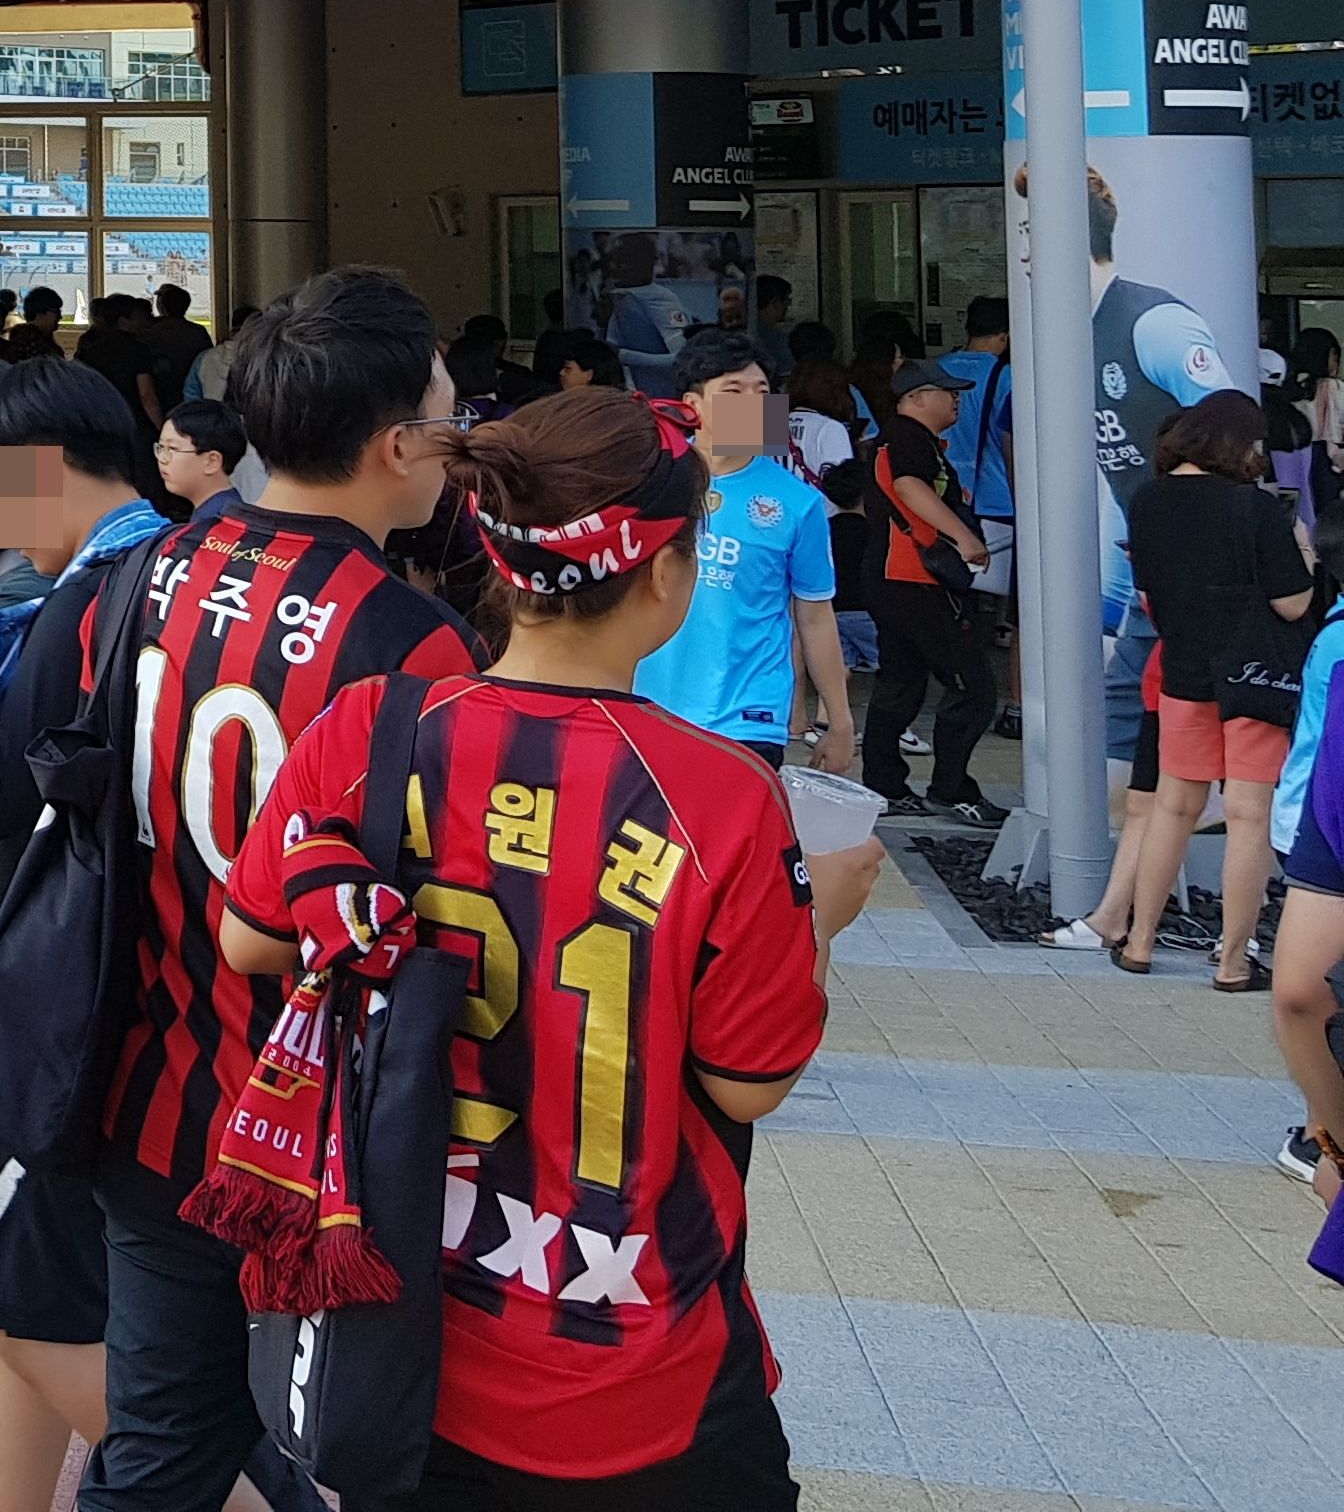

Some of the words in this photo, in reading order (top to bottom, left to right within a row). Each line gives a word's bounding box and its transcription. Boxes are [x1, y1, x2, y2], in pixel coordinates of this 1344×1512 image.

[1154, 38, 1229, 64] ANGEL
[872, 97, 988, 137] 예매자는
[672, 167, 730, 184] ANGEL
[1094, 410, 1126, 443] GB
[200, 536, 241, 558] Soul
[231, 548, 249, 562] of
[244, 547, 298, 572] Seoul
[695, 532, 741, 566] GB
